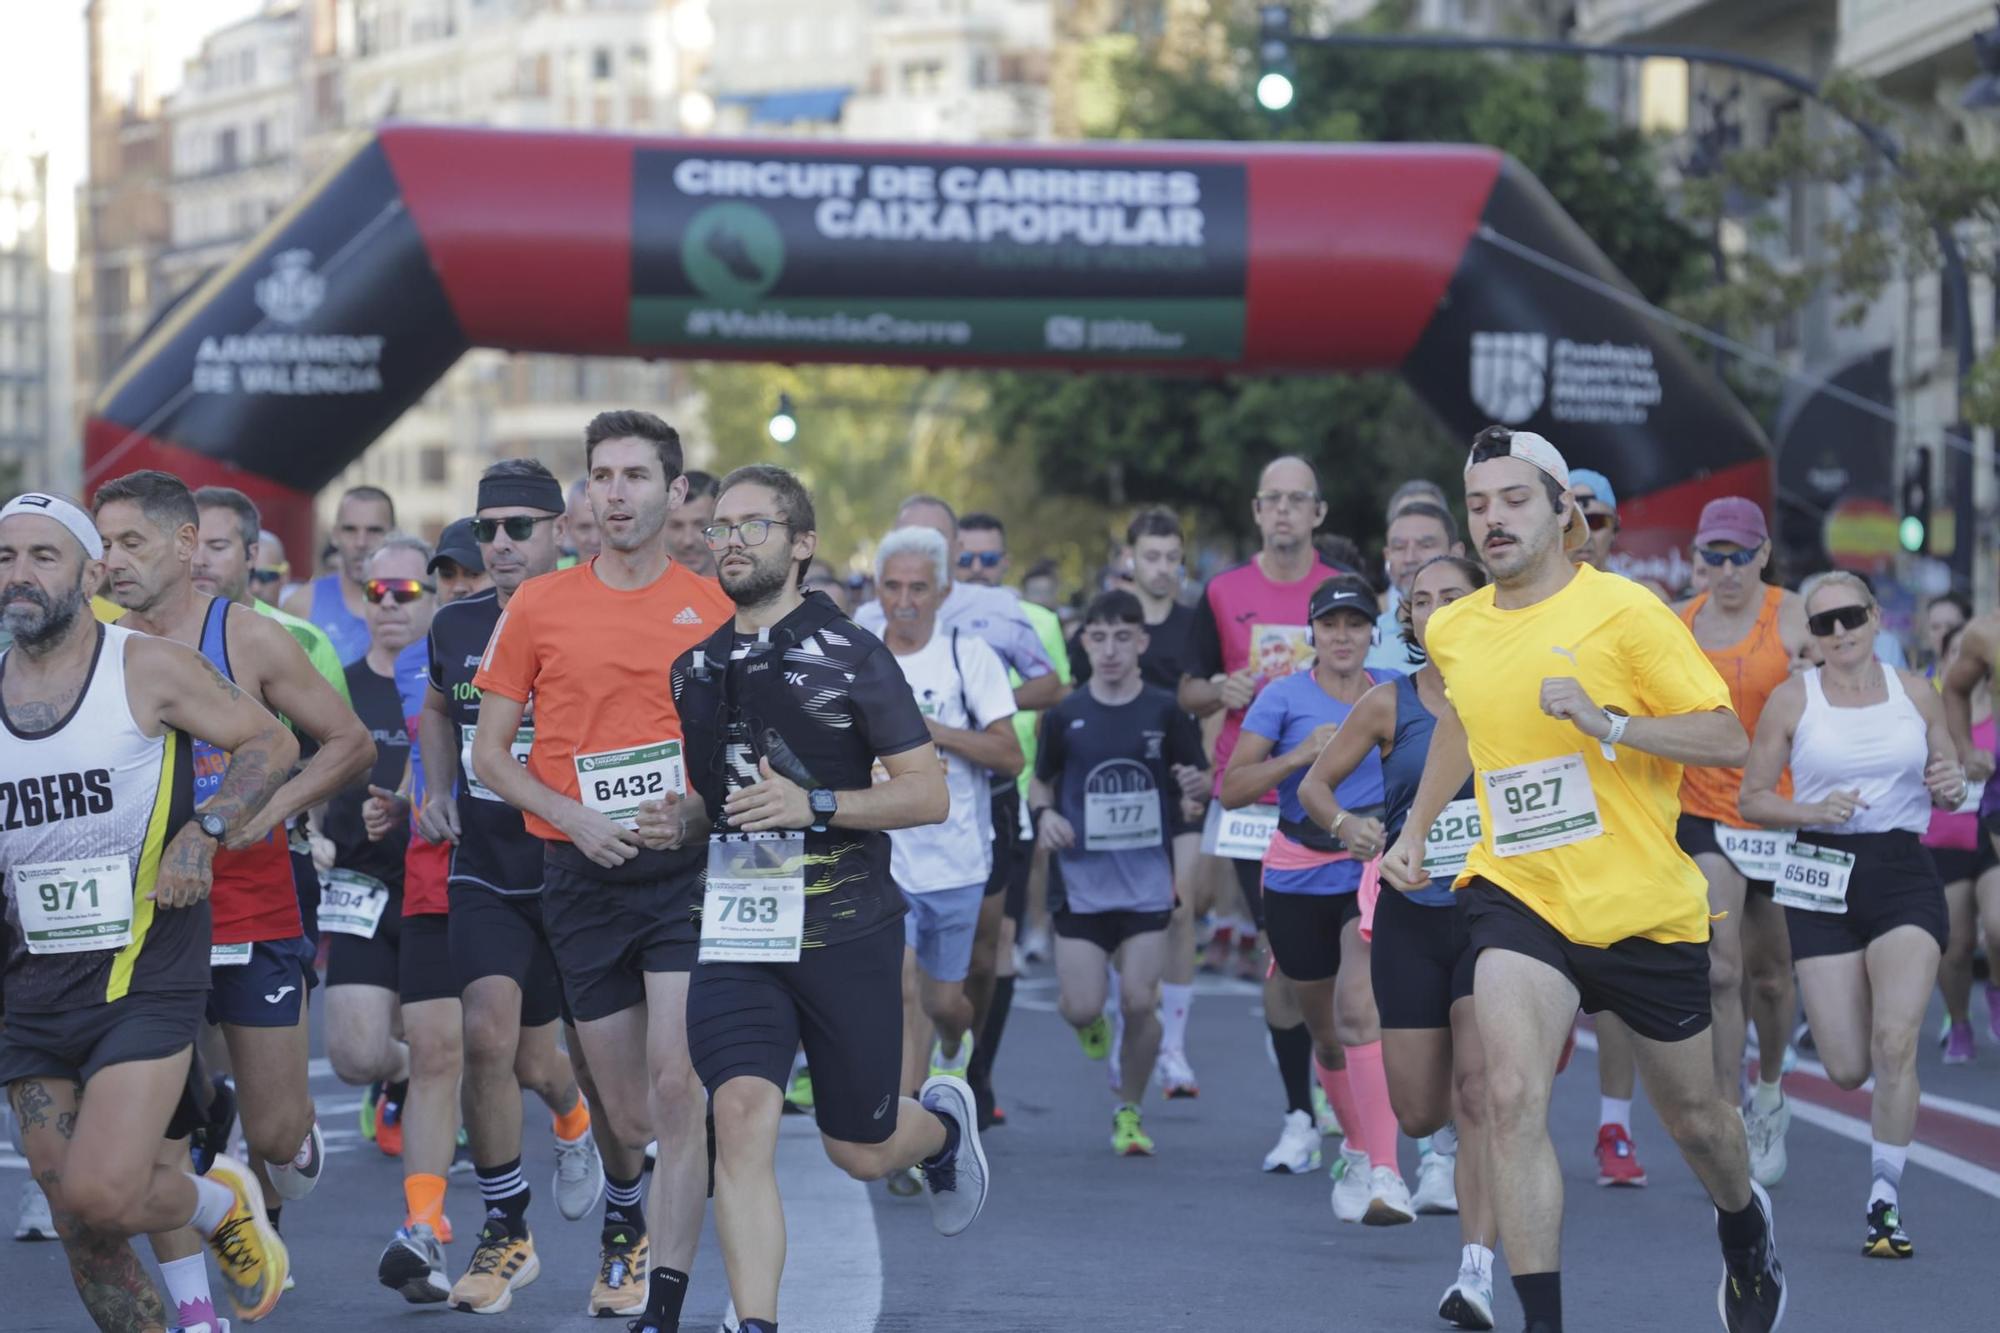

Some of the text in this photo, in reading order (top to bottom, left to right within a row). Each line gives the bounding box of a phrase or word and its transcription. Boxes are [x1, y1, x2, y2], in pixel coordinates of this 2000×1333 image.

[674, 159, 1200, 204] CIRCUIT DE CARRERES
[195, 335, 384, 361] AJUNTAMENT
[192, 363, 233, 393] DE
[0, 768, 113, 832] 26ERS
[594, 771, 664, 801] 6432
[1504, 777, 1562, 815] 927
[1105, 805, 1144, 823] 177
[1725, 837, 1777, 856] 6433
[1784, 863, 1830, 888] 6569
[38, 879, 98, 912] 971
[718, 895, 778, 924] 763
